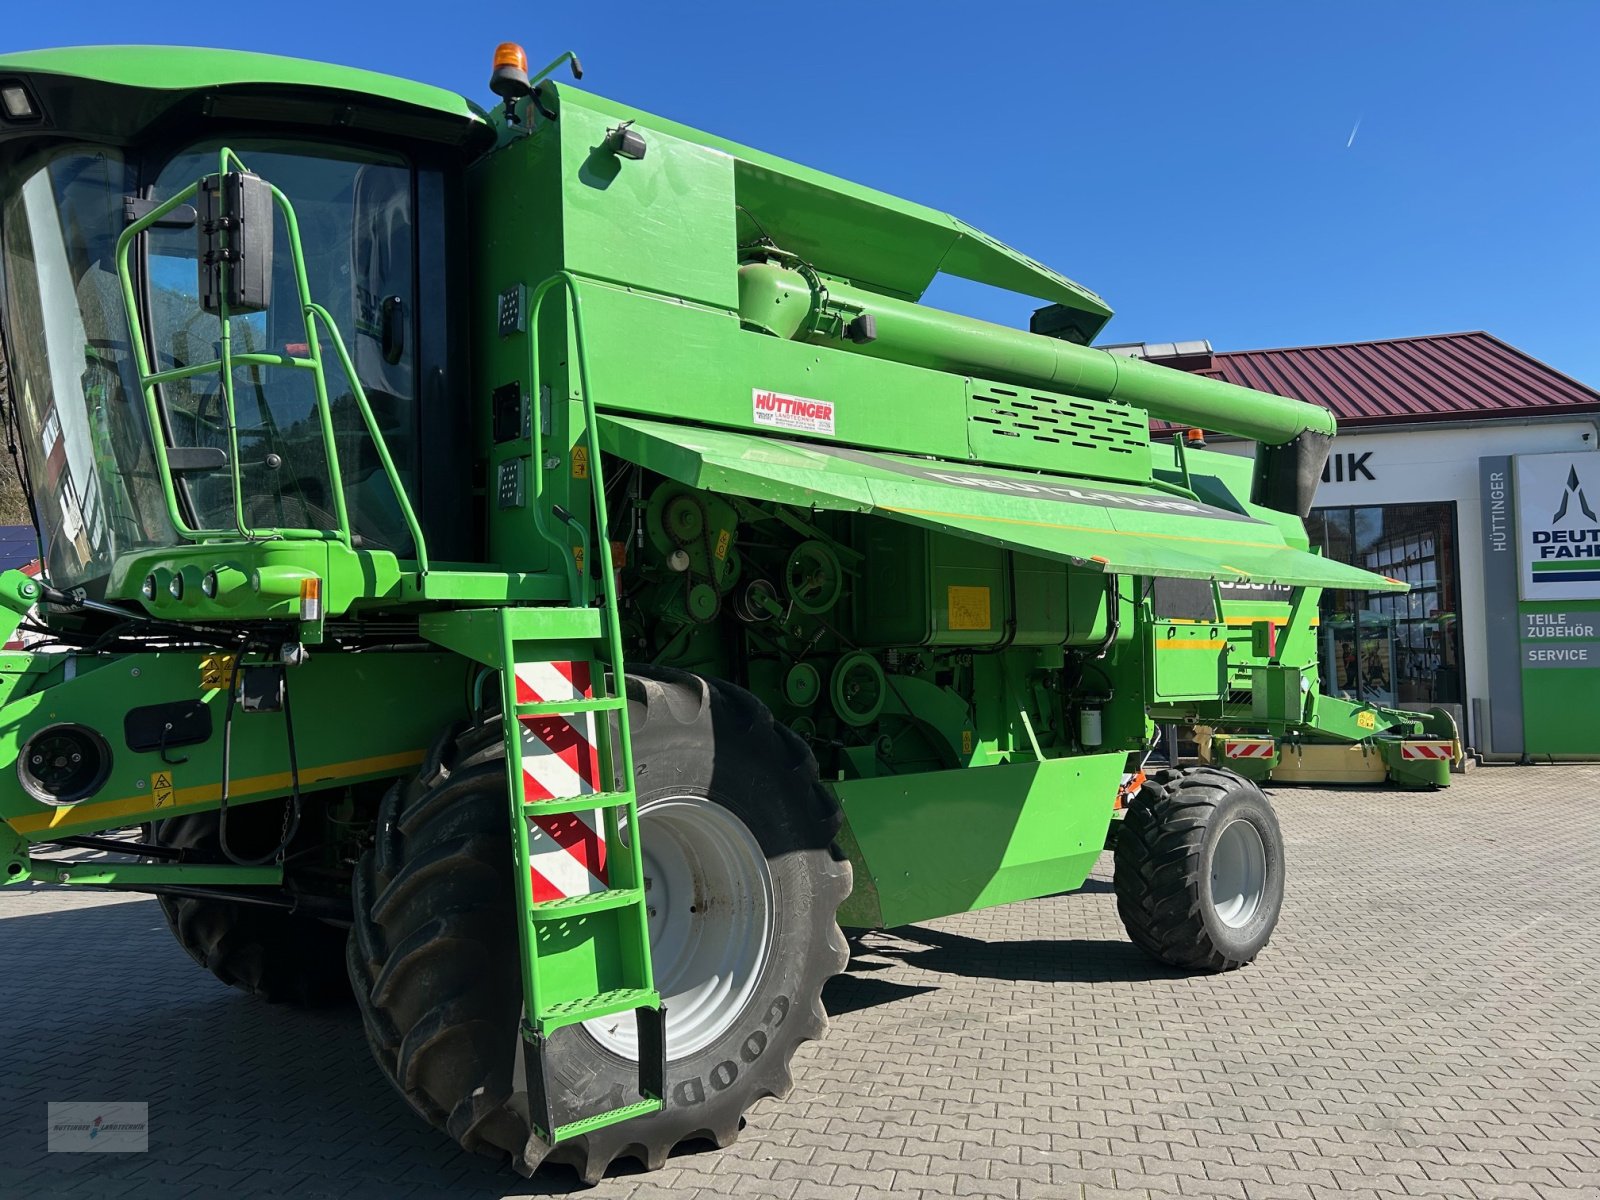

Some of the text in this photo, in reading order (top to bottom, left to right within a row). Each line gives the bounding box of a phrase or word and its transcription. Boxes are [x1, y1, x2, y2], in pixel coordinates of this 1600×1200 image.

[756, 393, 832, 421] HÜTTINGER
[1489, 472, 1507, 552] HÜTTINGER
[1527, 613, 1567, 625] TEILE
[1527, 624, 1594, 638] ZUBEHÖR
[1528, 649, 1588, 662] SERVICE
